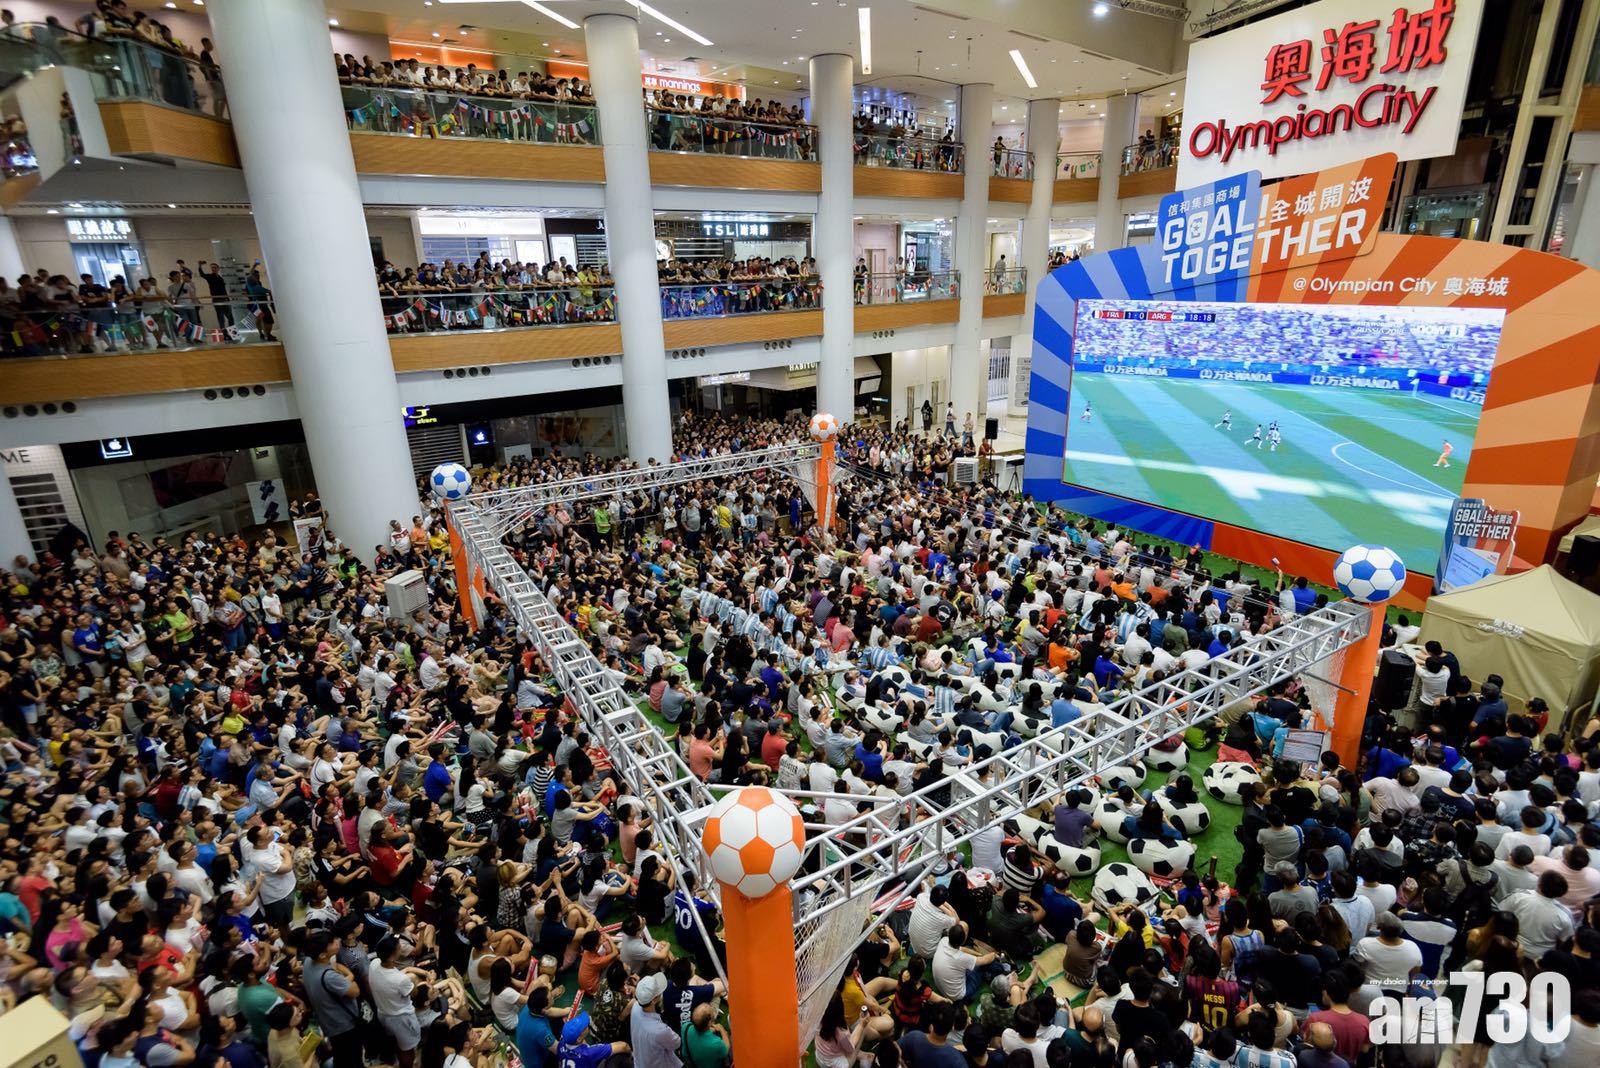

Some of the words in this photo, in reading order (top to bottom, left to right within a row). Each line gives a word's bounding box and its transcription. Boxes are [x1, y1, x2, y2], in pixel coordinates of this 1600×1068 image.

[1260, 0, 1456, 105] 奧海城
[659, 79, 701, 94] mannings
[1168, 185, 1241, 217] 信和集團商場
[1270, 176, 1374, 225] 全城開波
[703, 224, 735, 236] TSL
[1161, 208, 1367, 284] TOGETHER
[1293, 277, 1306, 291] @
[1310, 278, 1394, 294] Olympian
[1399, 277, 1437, 294] City
[1443, 277, 1509, 297] 奧海城
[1106, 310, 1120, 318] FRA
[1151, 312, 1167, 320] ARG
[1453, 522, 1511, 540] TOGETHER
[1204, 993, 1225, 1004] MESSI
[1203, 1004, 1228, 1030] 10
